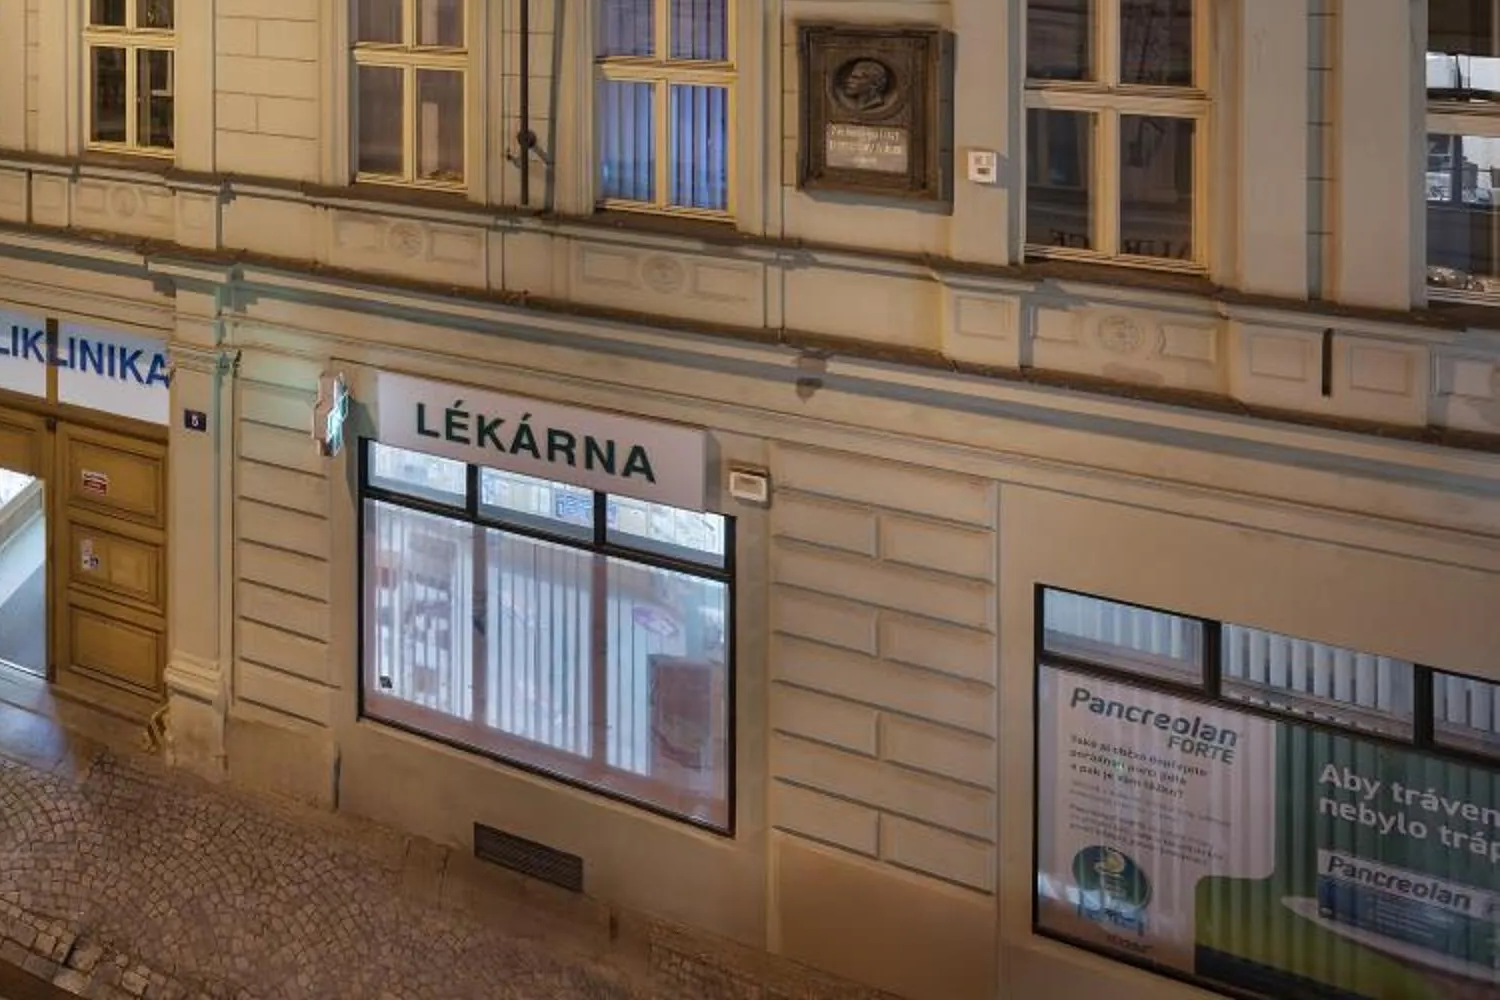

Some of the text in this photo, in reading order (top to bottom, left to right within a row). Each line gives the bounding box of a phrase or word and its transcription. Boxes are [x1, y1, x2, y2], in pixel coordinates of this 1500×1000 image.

[416, 399, 657, 485] LÉKÁRNA
[1070, 687, 1238, 747] Pancreolan
[1167, 735, 1236, 766] FORTE
[1319, 763, 1500, 828] Aby tráven
[1319, 796, 1428, 840] nebylo
[1327, 855, 1473, 911] Pancreolan
